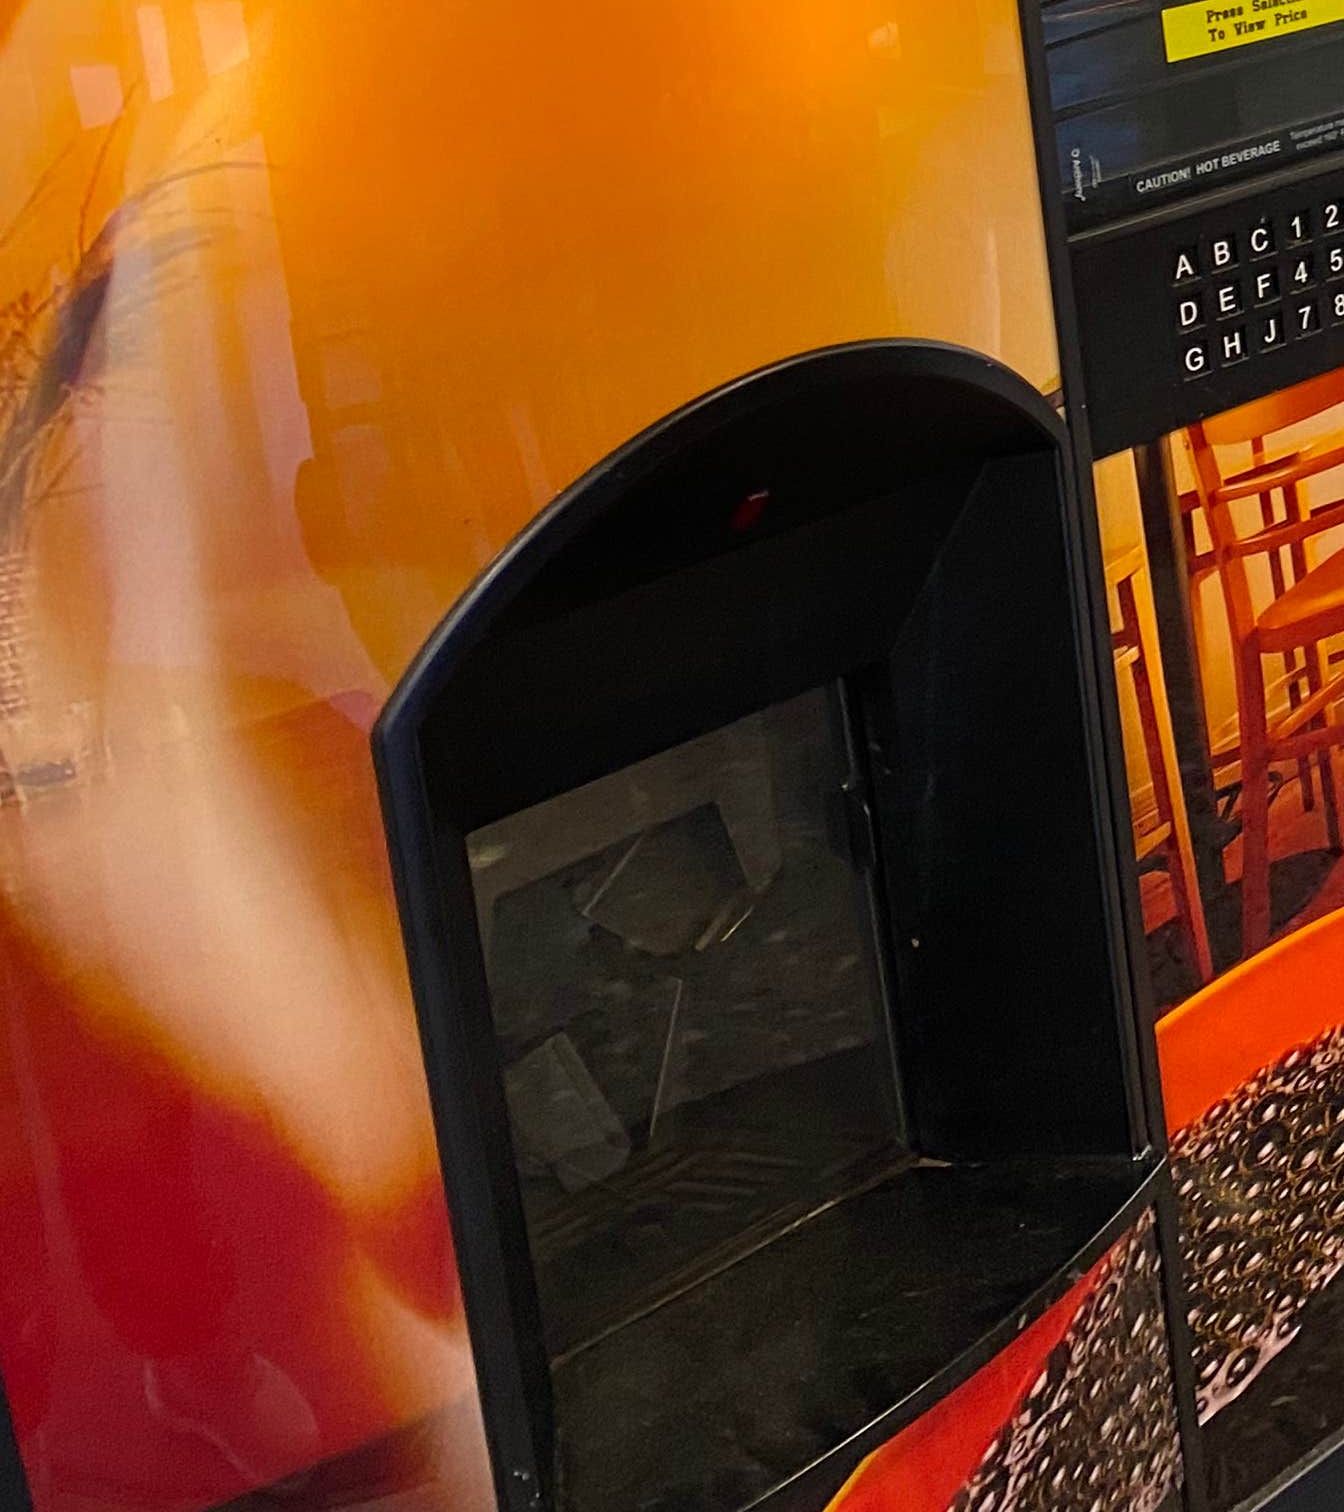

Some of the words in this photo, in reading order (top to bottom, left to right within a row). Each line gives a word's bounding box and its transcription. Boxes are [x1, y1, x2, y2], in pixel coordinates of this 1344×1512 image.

[1206, 7, 1243, 24] Press
[1208, 28, 1225, 42] To
[1235, 20, 1265, 38] View
[1275, 9, 1307, 28] Price
[1136, 167, 1191, 193] CAUTION!
[1196, 159, 1221, 176] HOT
[1222, 140, 1281, 168] BEVERAGE
[1175, 254, 1194, 280] A
[1214, 240, 1231, 266] B
[1251, 228, 1269, 252] C
[1291, 216, 1302, 238] 1
[1325, 204, 1339, 228] 2
[1180, 301, 1198, 326] D
[1219, 287, 1236, 313] E
[1257, 273, 1271, 298] F
[1294, 261, 1308, 284] 4
[1330, 248, 1344, 272] 5
[1185, 347, 1205, 372] G
[1223, 332, 1242, 359] H
[1264, 319, 1276, 343] J
[1298, 306, 1312, 330] 7
